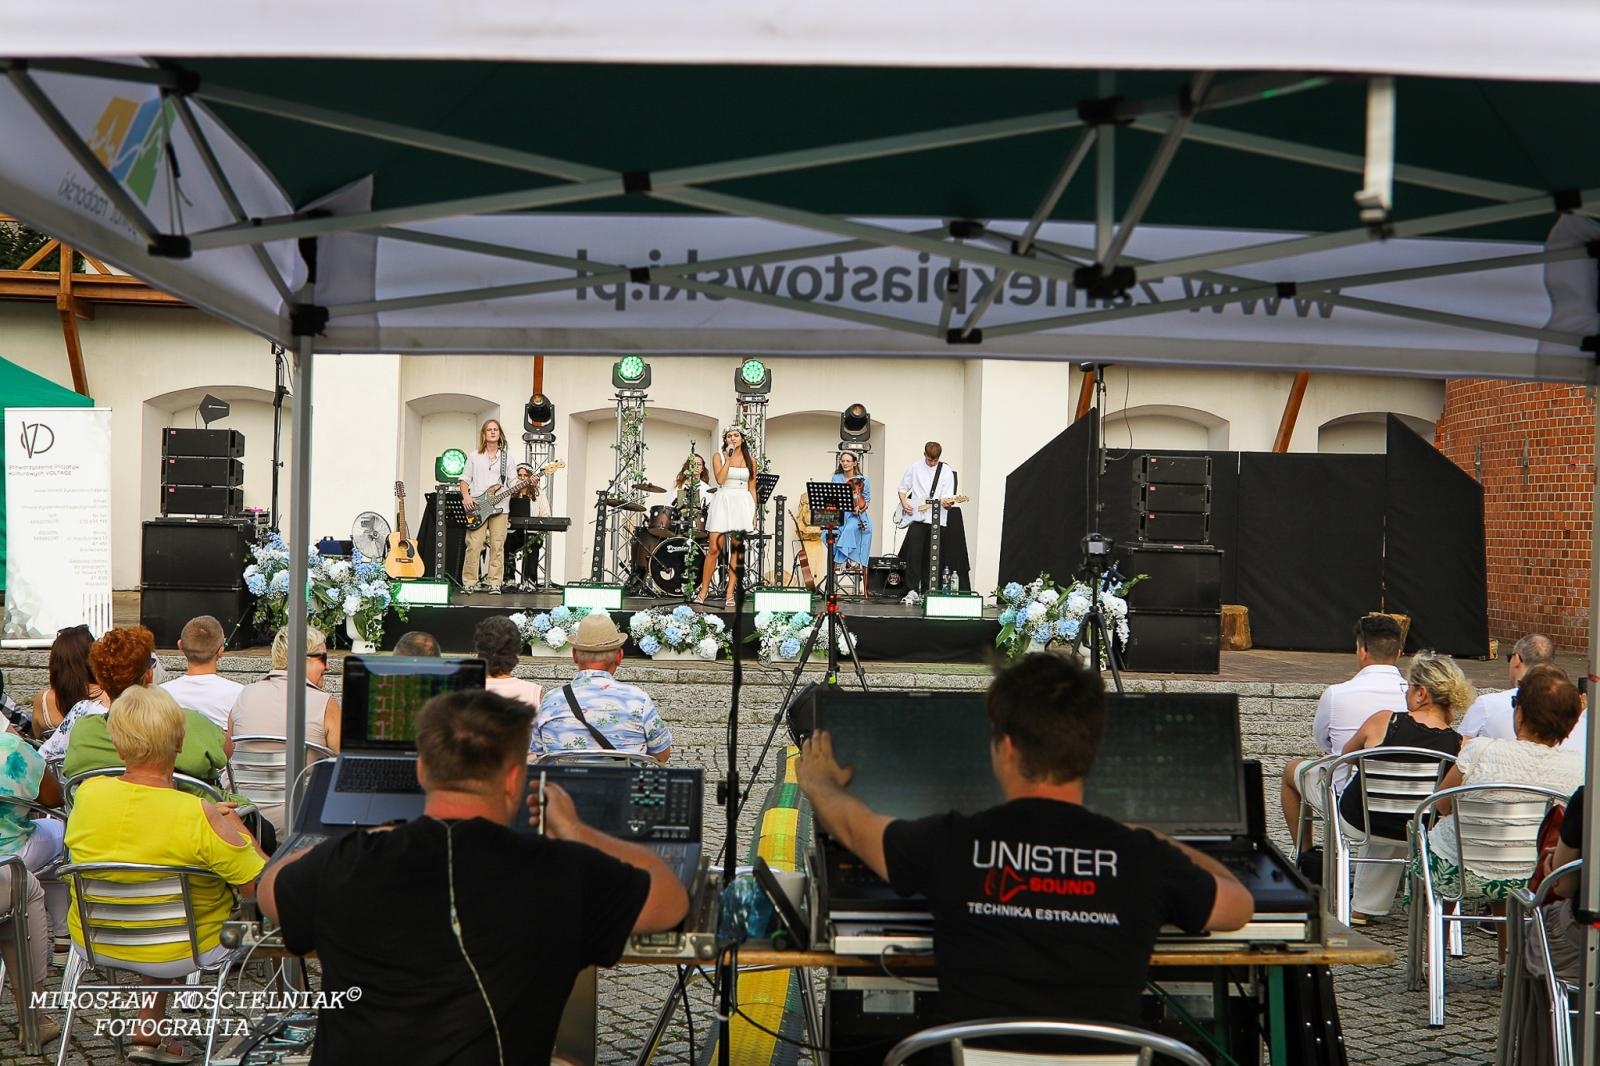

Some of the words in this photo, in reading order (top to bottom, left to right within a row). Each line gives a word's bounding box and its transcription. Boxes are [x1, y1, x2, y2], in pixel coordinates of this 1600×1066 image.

[972, 839, 1119, 877] UNISTER
[1029, 877, 1097, 896] SOUND
[967, 901, 1033, 919] TECHNIKA
[1035, 908, 1120, 926] ESTRADOWA
